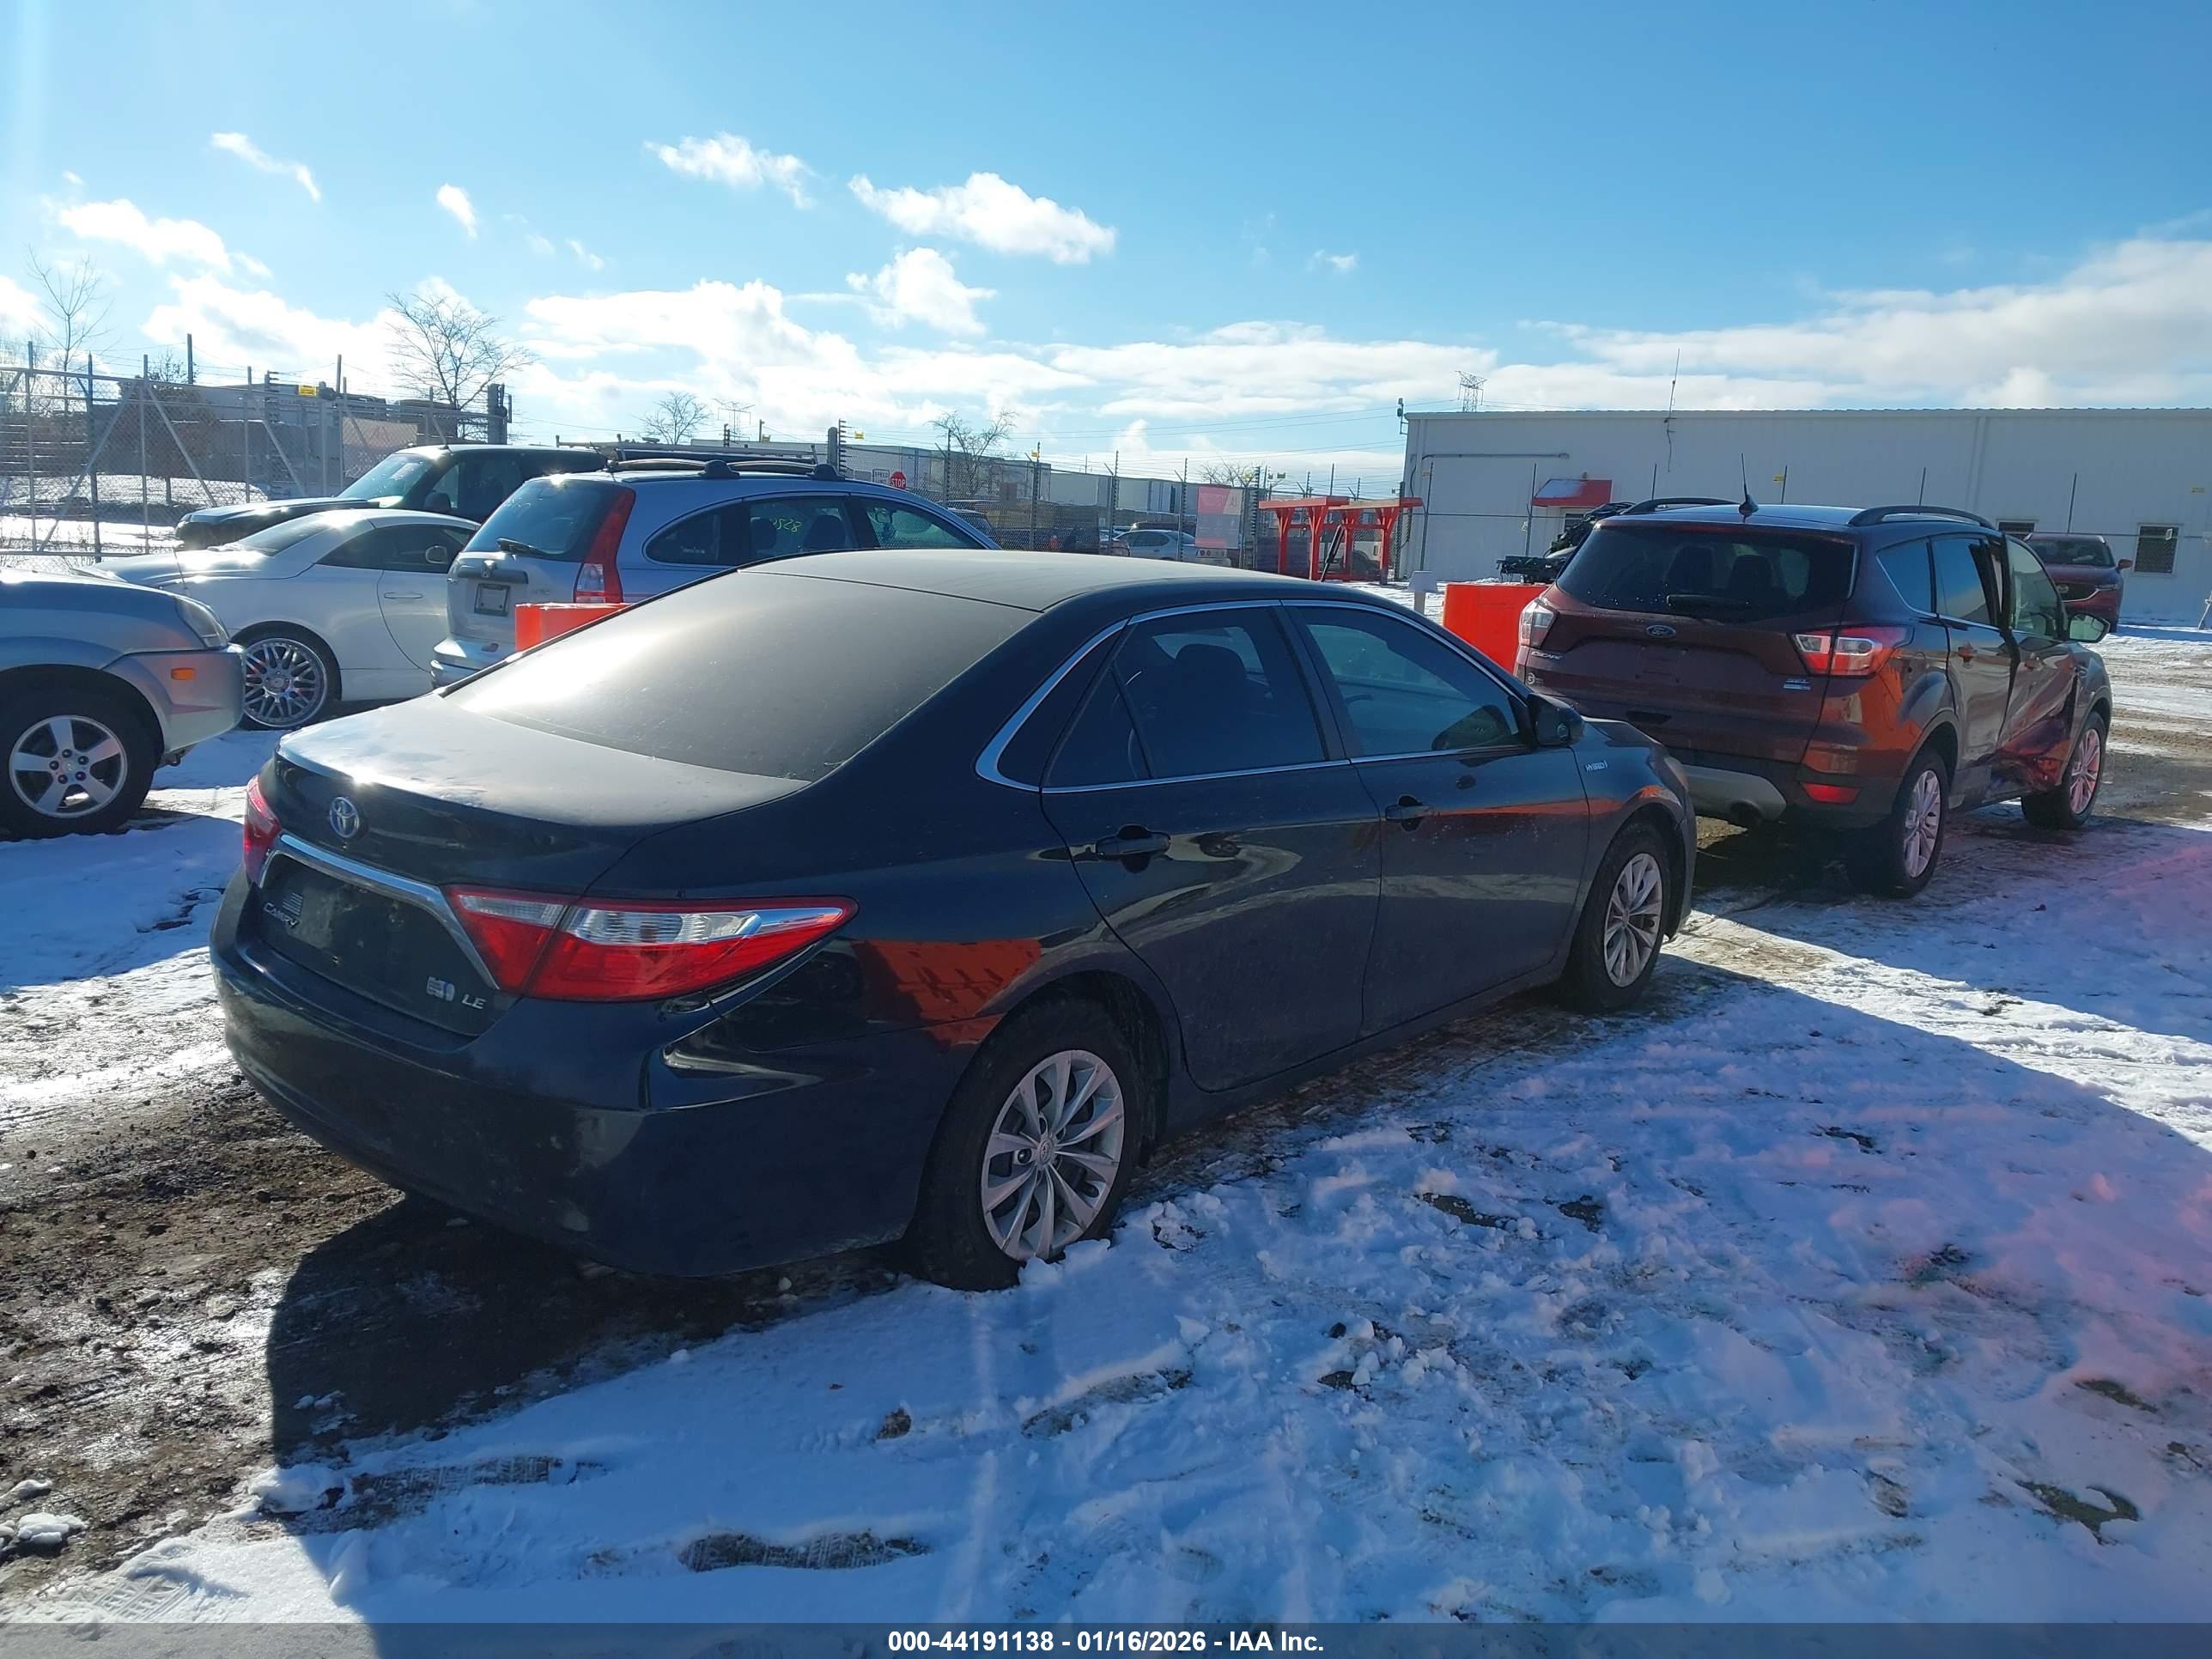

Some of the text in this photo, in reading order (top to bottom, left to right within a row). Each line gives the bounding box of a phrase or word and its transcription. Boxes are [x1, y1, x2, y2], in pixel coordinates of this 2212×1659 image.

[891, 477, 907, 489] STOP
[264, 902, 298, 928] CAMRY
[461, 994, 487, 1010] LE
